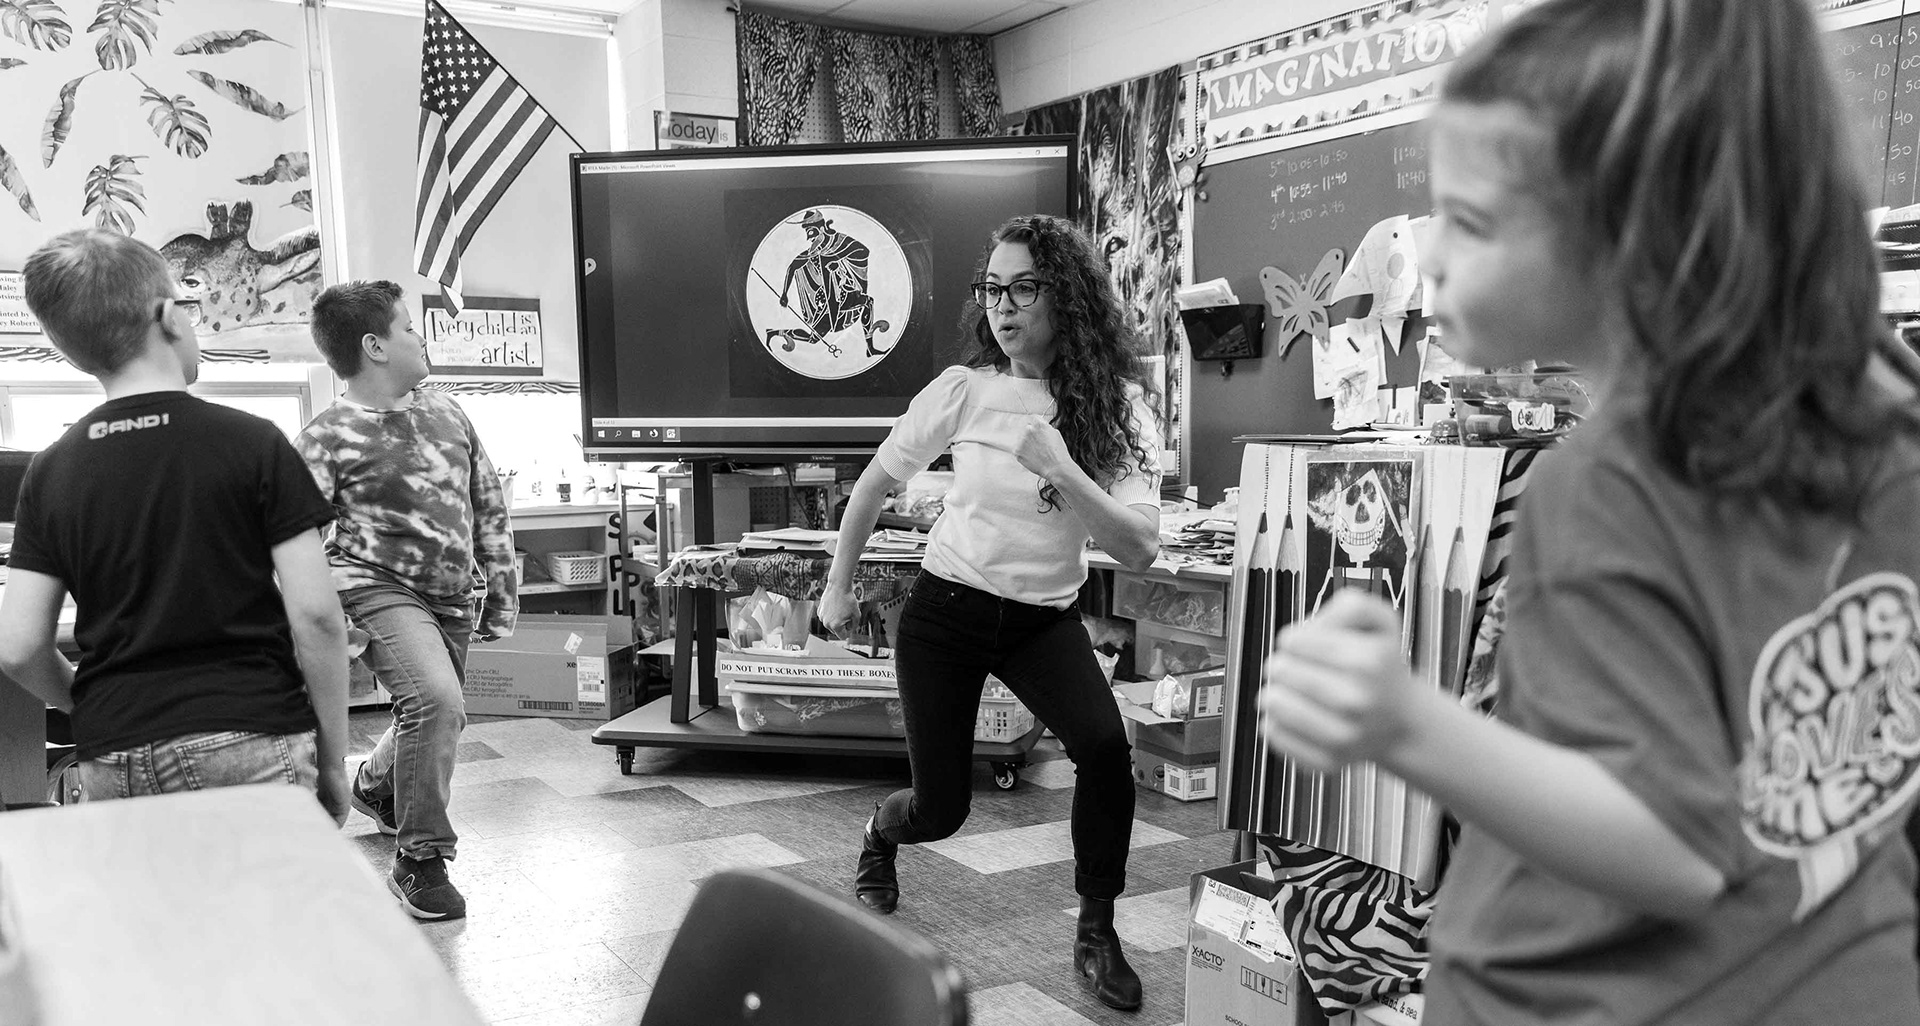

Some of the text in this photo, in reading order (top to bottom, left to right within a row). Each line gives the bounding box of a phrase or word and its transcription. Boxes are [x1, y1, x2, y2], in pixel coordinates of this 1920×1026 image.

[667, 119, 728, 144] Today is
[429, 309, 537, 342] Every child is an
[721, 663, 896, 679] DO NOT PUT SCRAPS INTO THESE BOXES
